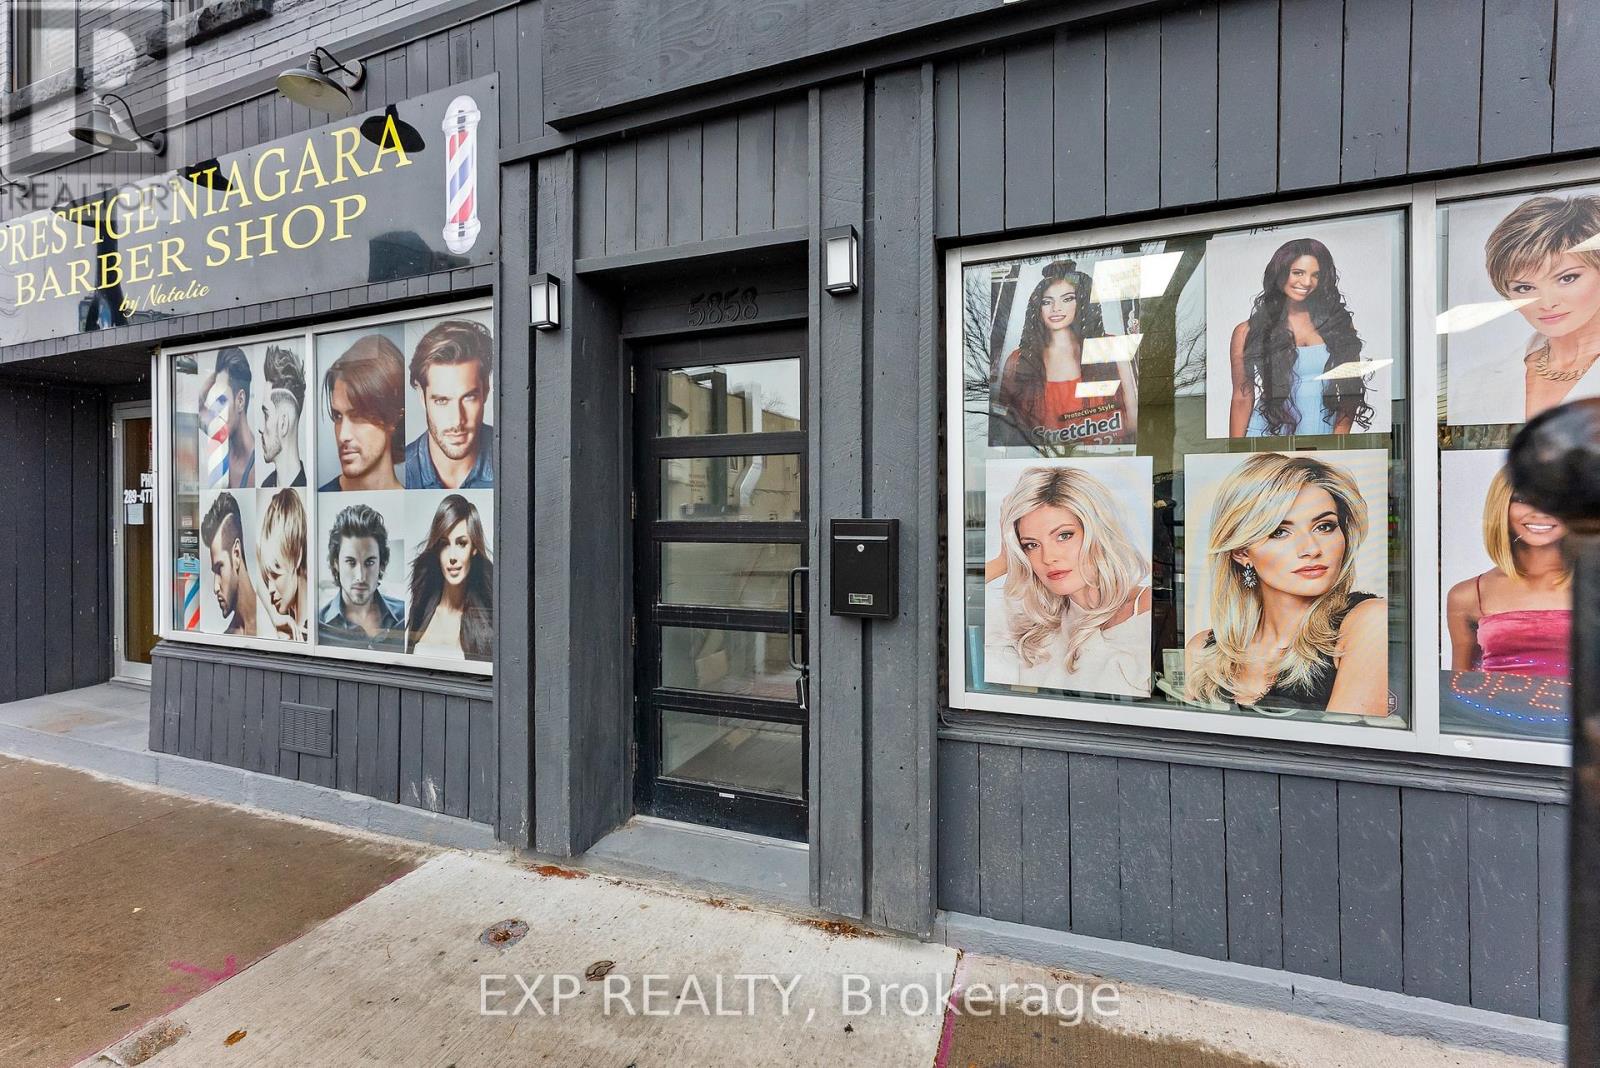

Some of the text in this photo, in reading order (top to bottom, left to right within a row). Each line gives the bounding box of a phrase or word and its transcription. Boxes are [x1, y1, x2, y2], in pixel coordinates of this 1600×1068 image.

[169, 114, 412, 226] NIAGARA
[14, 194, 367, 308] BARBER SHOP
[119, 279, 209, 318] by Natalie
[687, 287, 758, 328] 5858
[1032, 411, 1123, 443] Stretched
[1064, 403, 1115, 420] Protective Style
[1451, 670, 1573, 711] OPE
